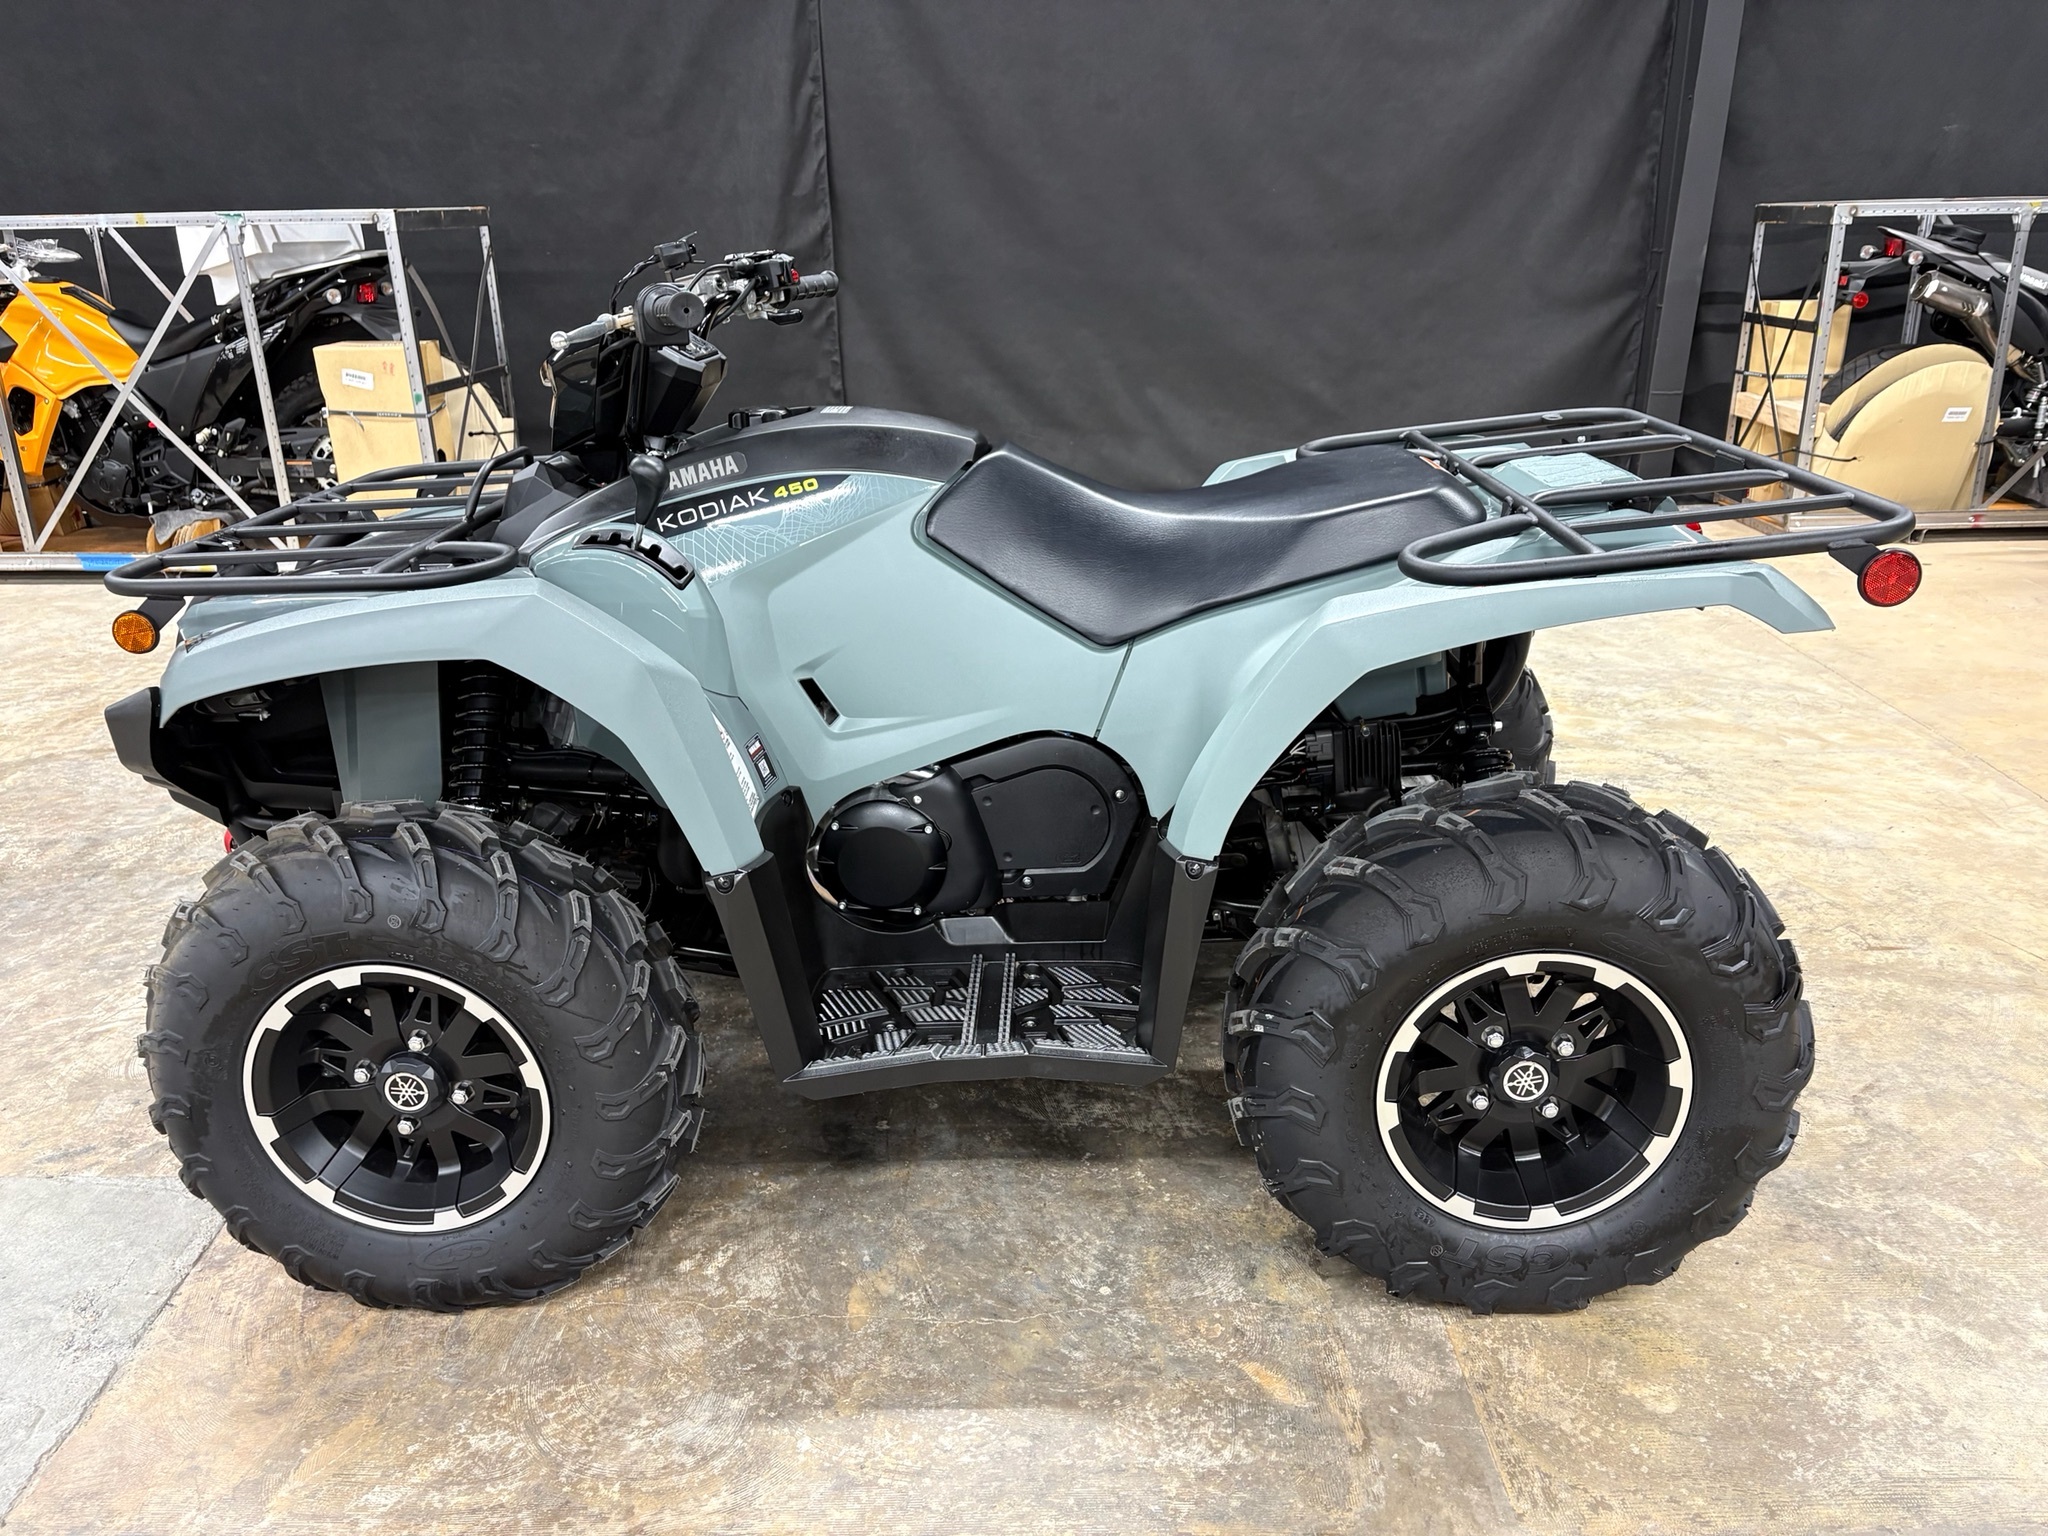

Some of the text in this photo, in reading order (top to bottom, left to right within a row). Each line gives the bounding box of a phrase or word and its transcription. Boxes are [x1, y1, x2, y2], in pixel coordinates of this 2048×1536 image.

[668, 454, 740, 491] AMAHA
[656, 477, 819, 533] KODIAK 450
[1441, 1237, 1571, 1275] CST
